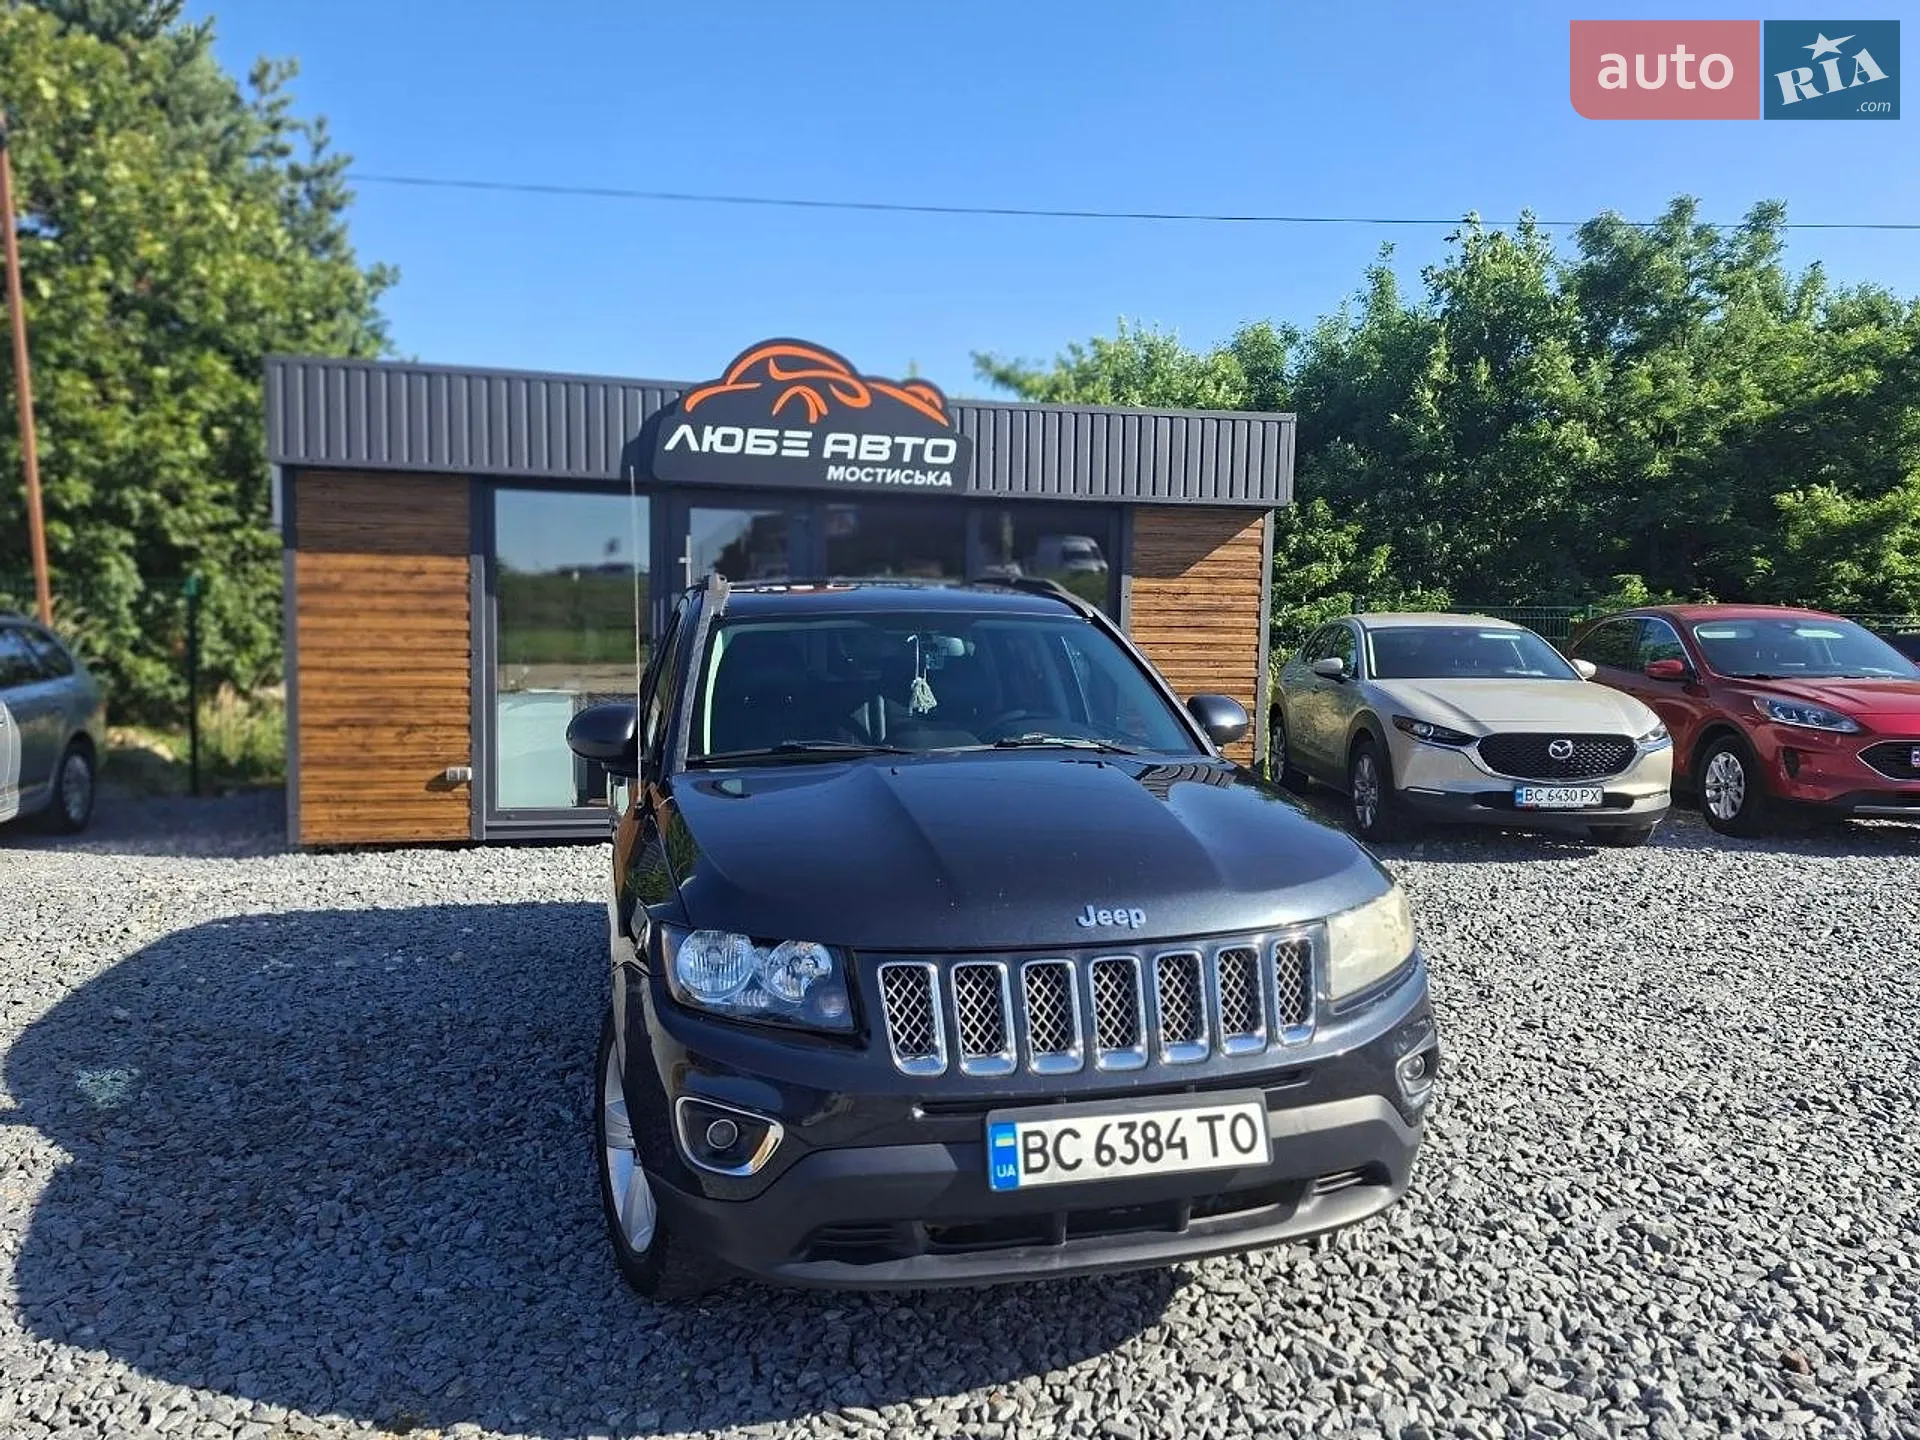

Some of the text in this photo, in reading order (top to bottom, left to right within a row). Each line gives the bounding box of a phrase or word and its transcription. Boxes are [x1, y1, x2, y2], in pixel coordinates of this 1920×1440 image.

[664, 423, 957, 465] ЛЮБЕ АВТО
[826, 464, 953, 488] МОСТИСЬКА
[1076, 904, 1147, 929] Jeep
[1022, 1112, 1258, 1175] BC 6384 TO
[997, 1163, 1017, 1178] UA
